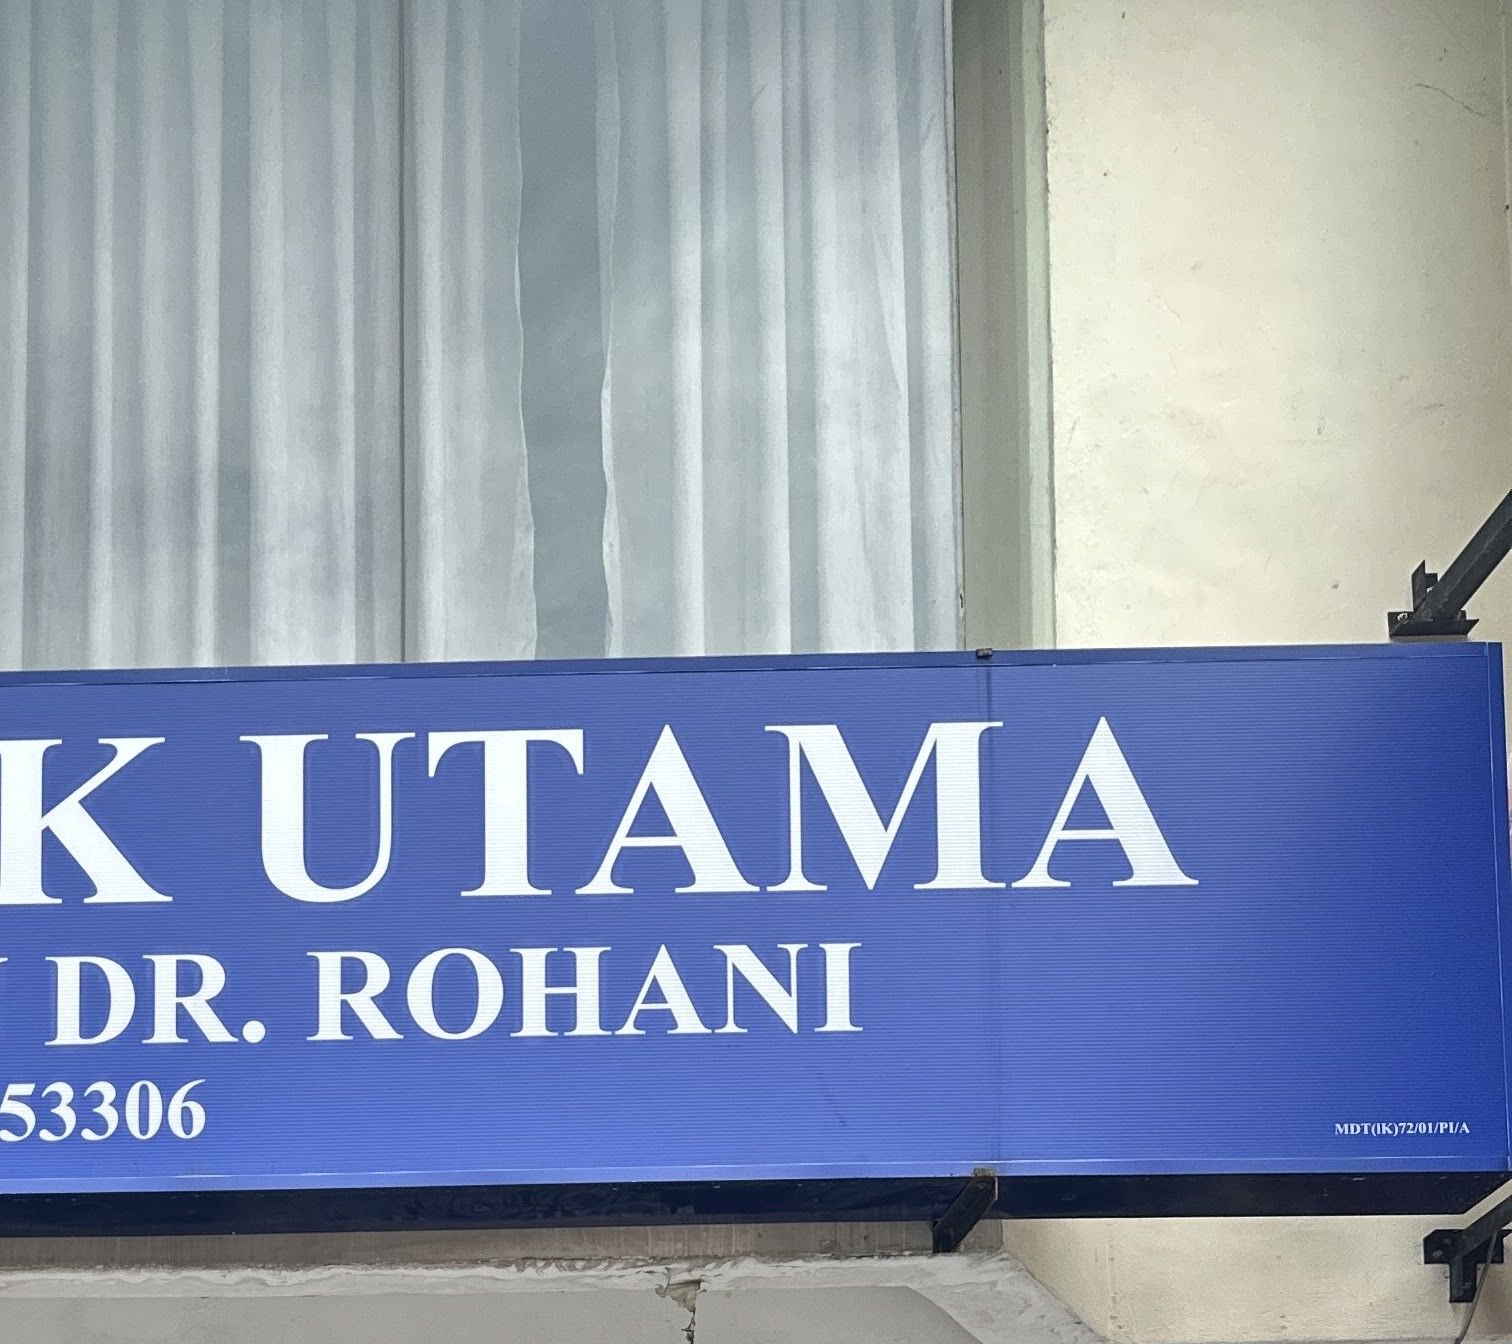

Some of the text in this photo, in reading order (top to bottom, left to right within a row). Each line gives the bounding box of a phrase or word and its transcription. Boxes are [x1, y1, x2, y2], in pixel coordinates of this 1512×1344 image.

[239, 716, 1199, 903] UTAMA
[44, 951, 267, 1045] DR.
[307, 941, 864, 1038] ROHANI
